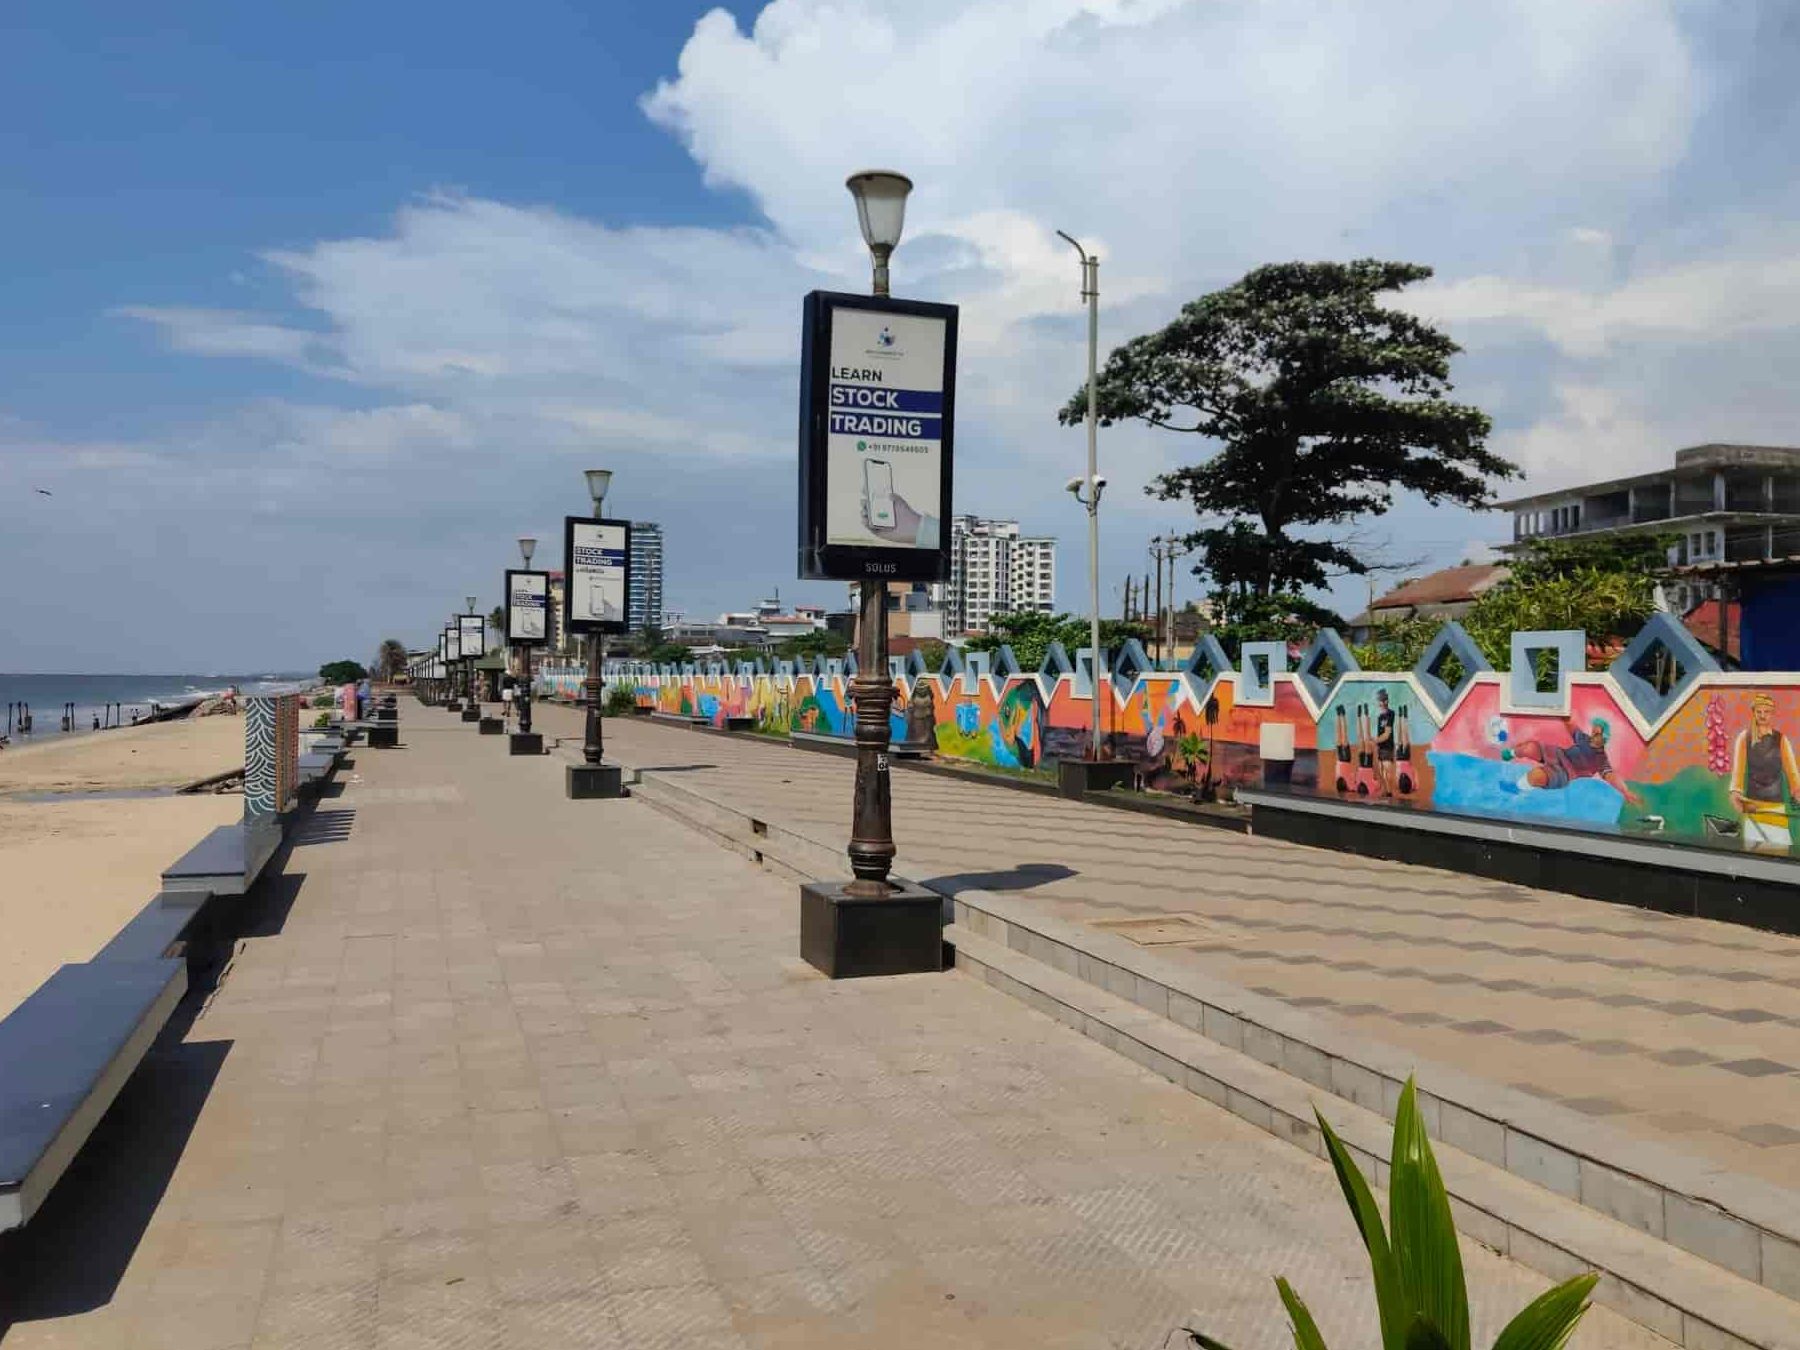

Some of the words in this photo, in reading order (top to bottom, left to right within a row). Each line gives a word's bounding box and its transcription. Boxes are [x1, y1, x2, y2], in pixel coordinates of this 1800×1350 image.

[831, 366, 883, 382] LEARN
[832, 387, 899, 408] STOCK
[831, 414, 922, 436] TRADING
[576, 547, 603, 555] STOCK
[576, 557, 613, 566] TRADING
[865, 563, 898, 573] SOLUS
